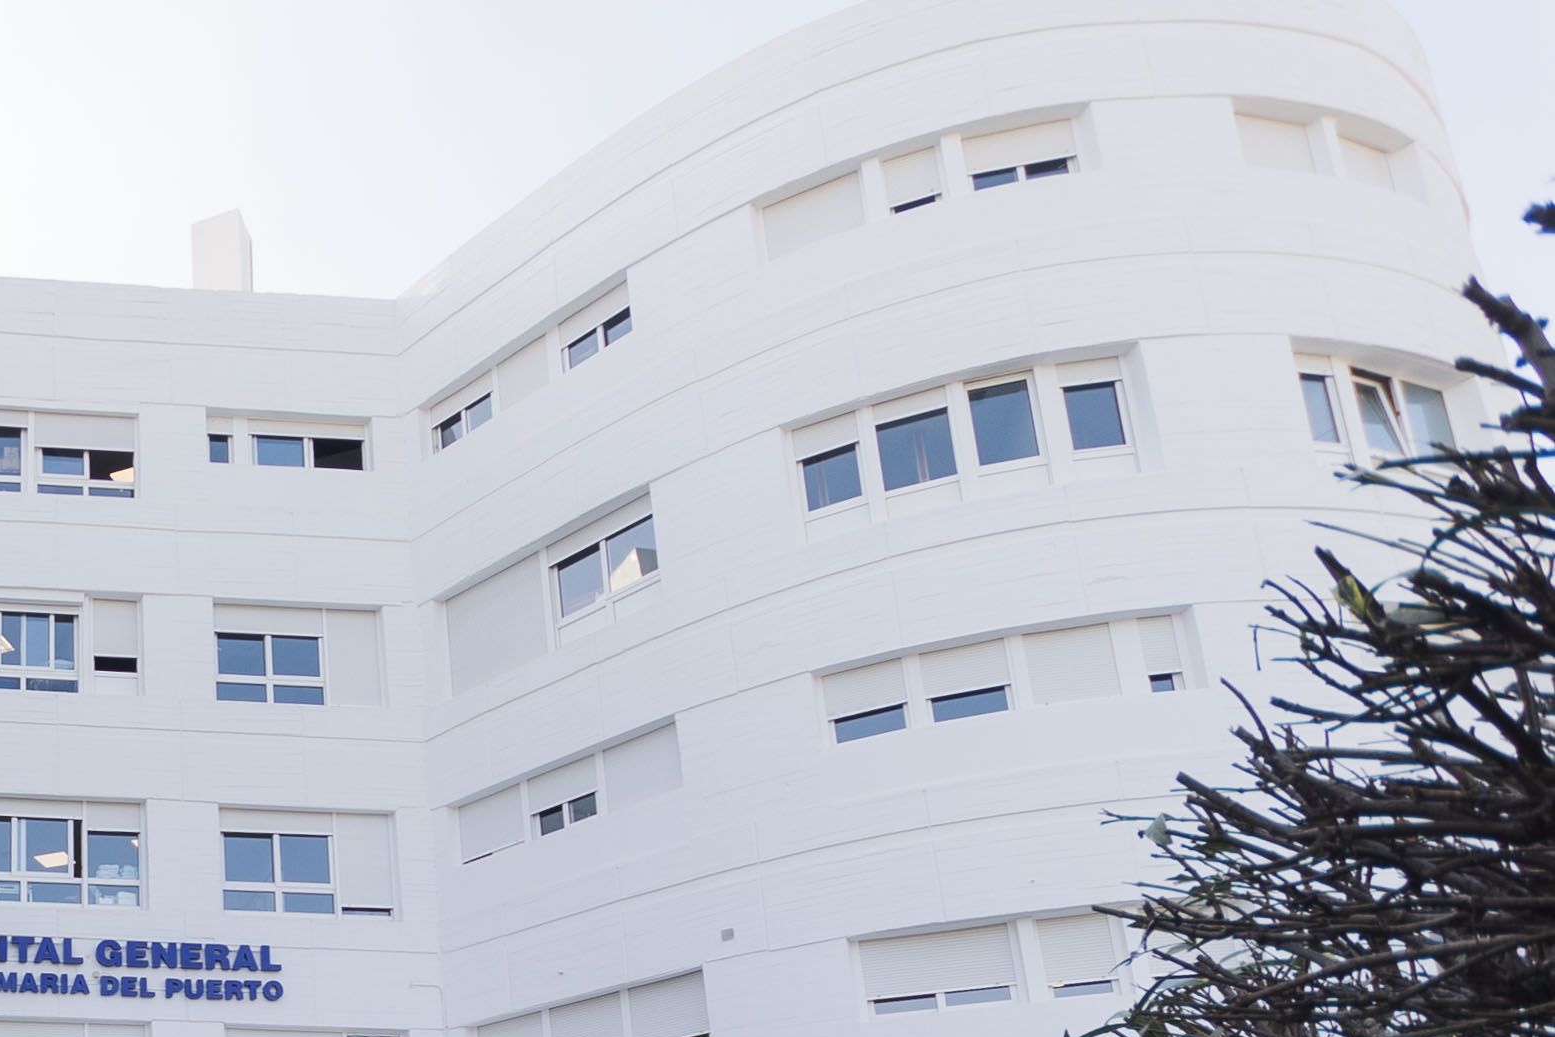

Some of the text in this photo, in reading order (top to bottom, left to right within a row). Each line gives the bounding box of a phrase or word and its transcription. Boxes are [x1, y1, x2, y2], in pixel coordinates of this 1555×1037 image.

[95, 938, 282, 972] GENERAL
[98, 975, 156, 998] DEL
[164, 977, 285, 1001] PUERTO
